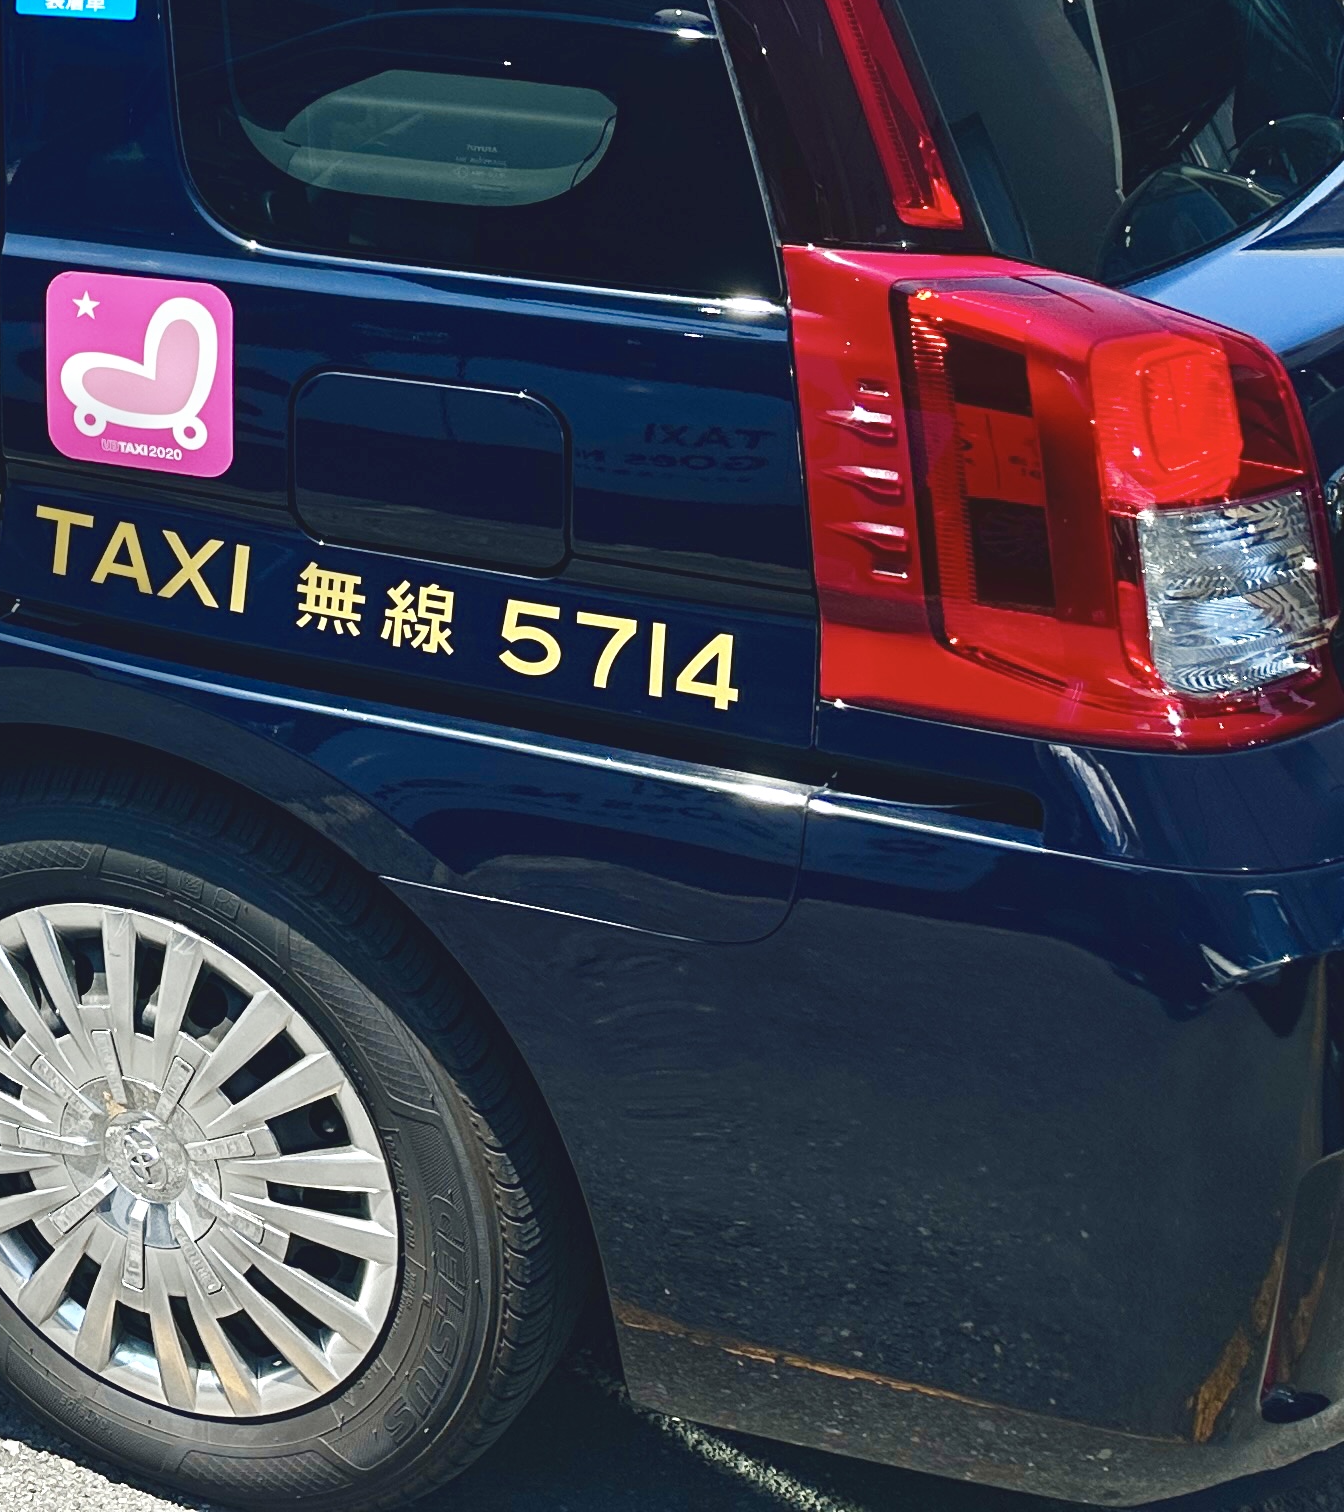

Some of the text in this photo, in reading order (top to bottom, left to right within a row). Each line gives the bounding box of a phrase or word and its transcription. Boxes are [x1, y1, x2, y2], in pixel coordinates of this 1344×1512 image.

[35, 504, 740, 712] TAXI 無線 5714
